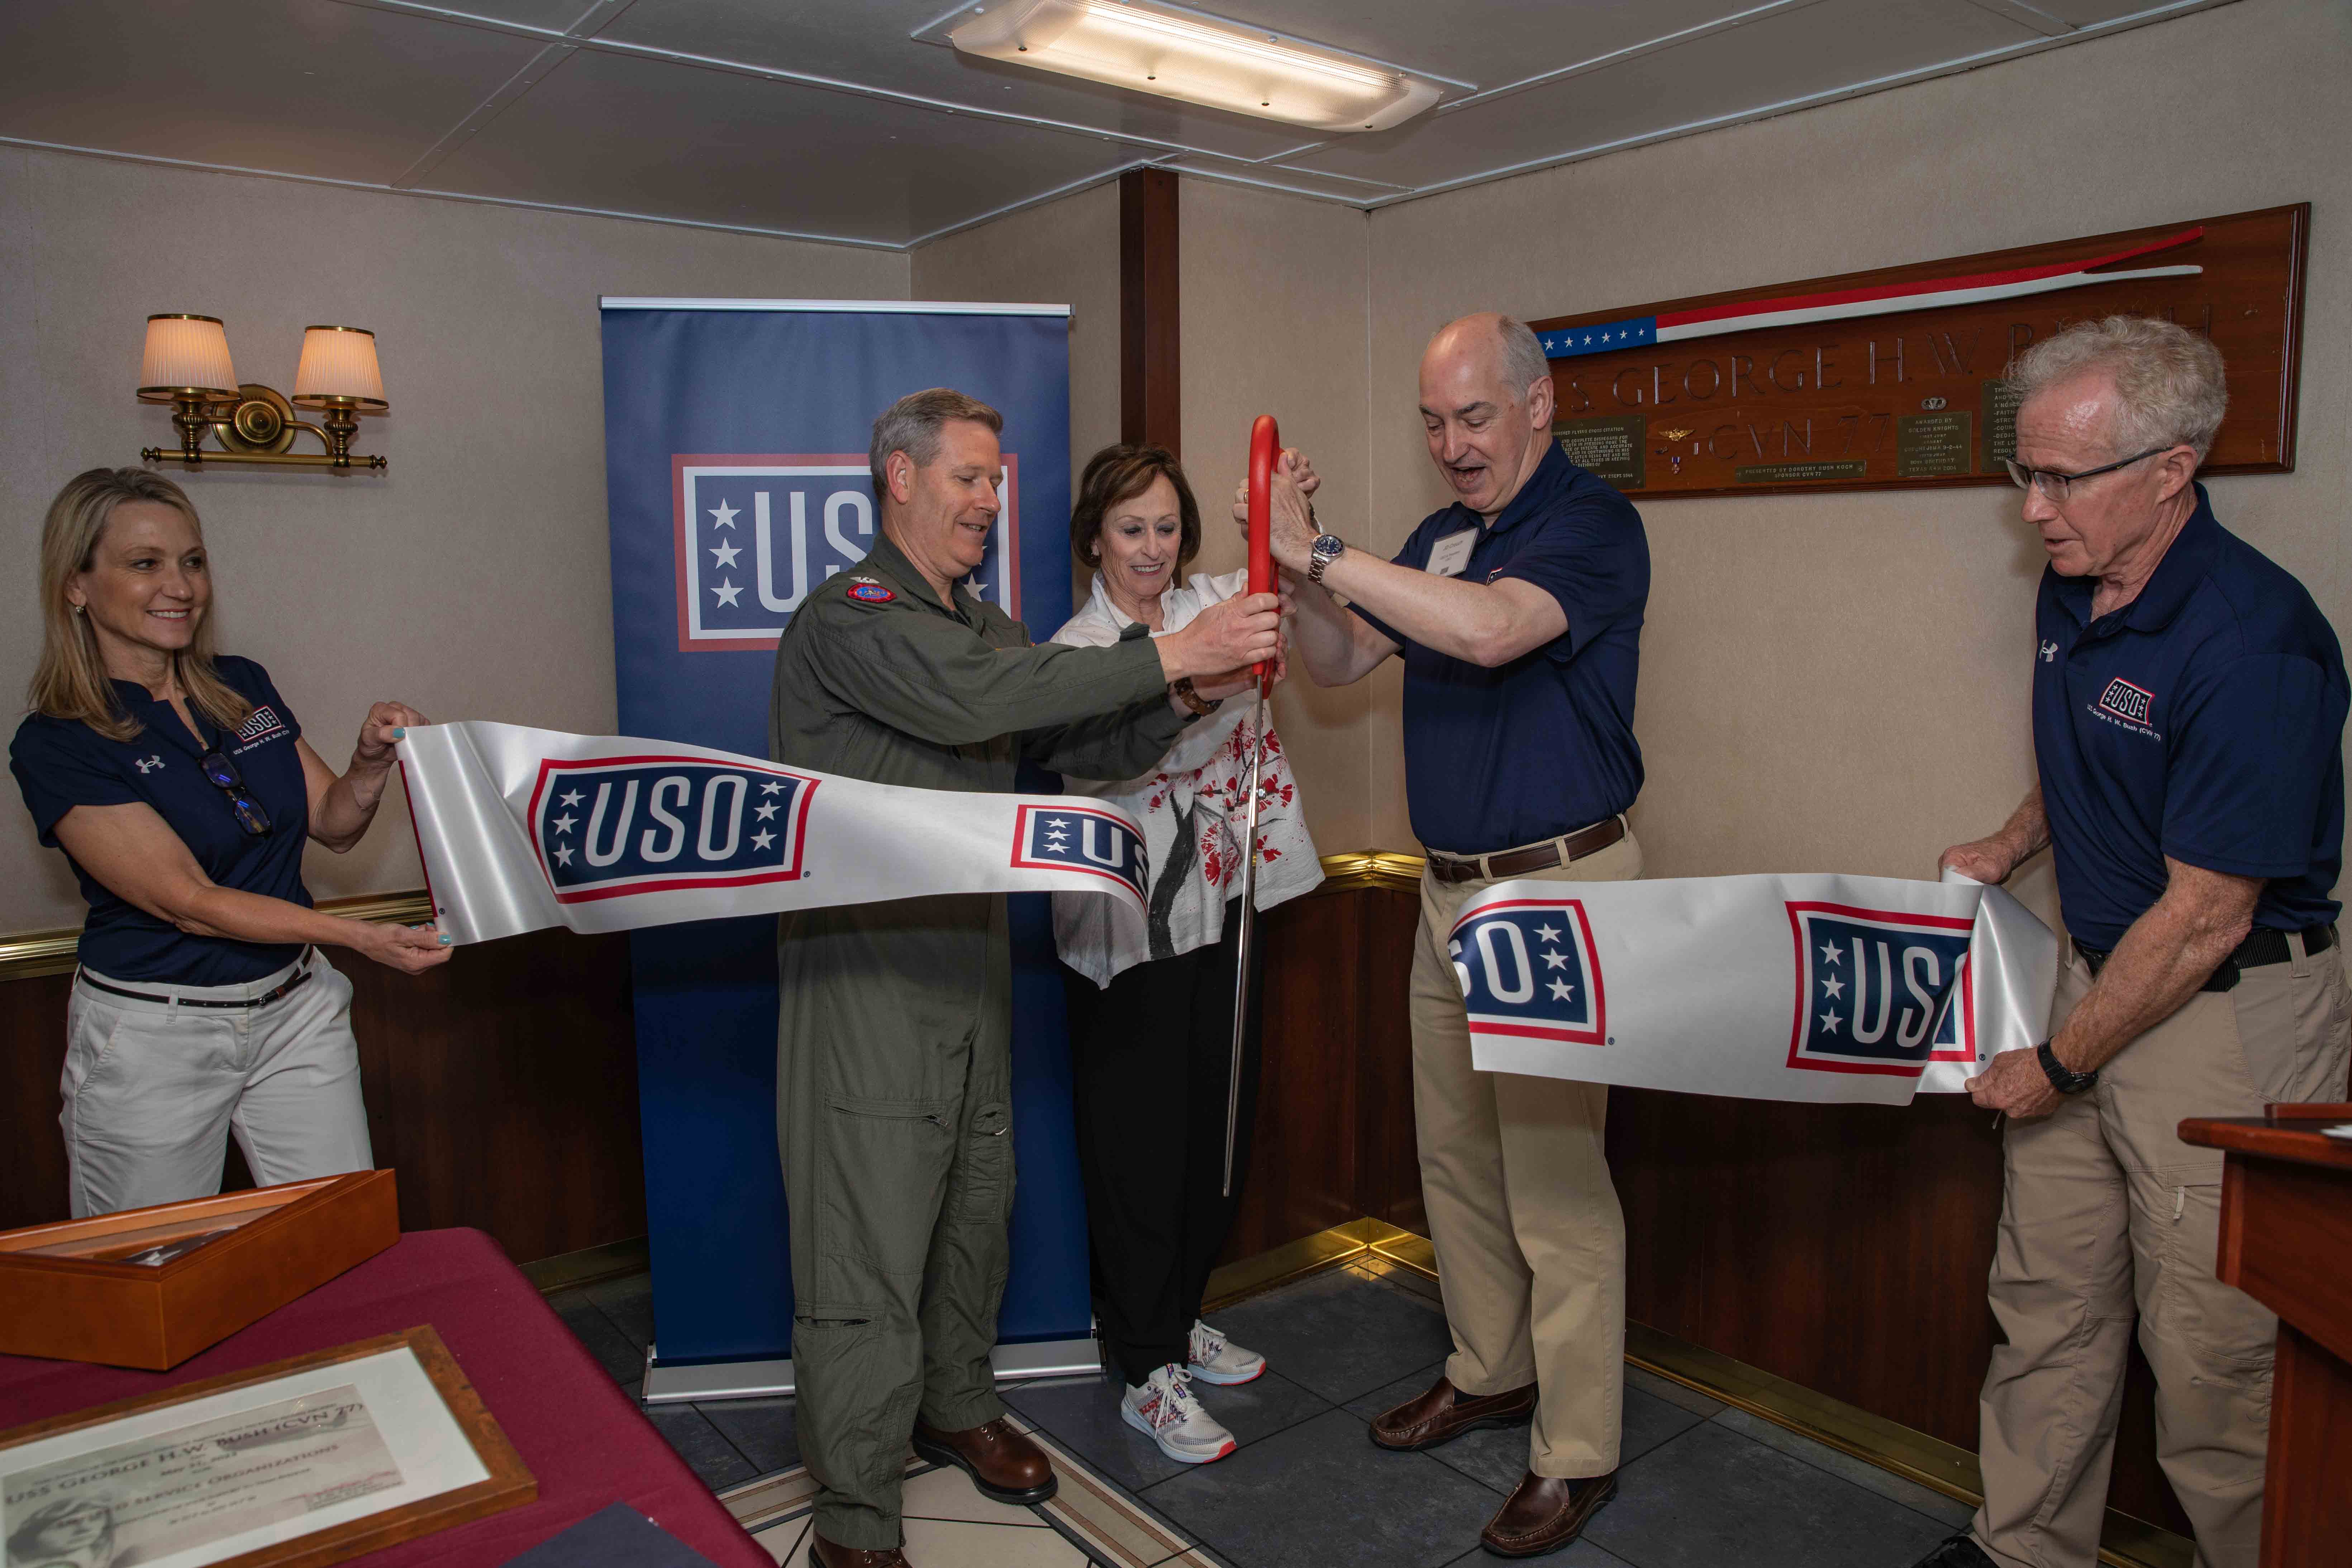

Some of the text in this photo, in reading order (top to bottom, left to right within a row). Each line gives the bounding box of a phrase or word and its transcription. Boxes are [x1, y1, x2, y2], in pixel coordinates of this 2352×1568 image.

[1613, 345, 1842, 407] GEORGE
[1708, 413, 1890, 460] CVN 77
[754, 491, 873, 613] US
[242, 713, 272, 735] USO
[2111, 686, 2141, 716] USO
[2123, 723, 2138, 731] Bush
[2139, 727, 2153, 737] (CVN
[243, 742, 259, 751] George
[585, 775, 748, 867] USO
[1852, 937, 1968, 1048] US
[5, 1486, 51, 1505] USS
[58, 1458, 150, 1489] GEORGE
[215, 1427, 269, 1447] BUSH
[274, 1411, 329, 1432] (CVN
[335, 1402, 363, 1417] 77)
[135, 1482, 201, 1505] SERVICE
[209, 1444, 339, 1484] ORGANIZATIONS
